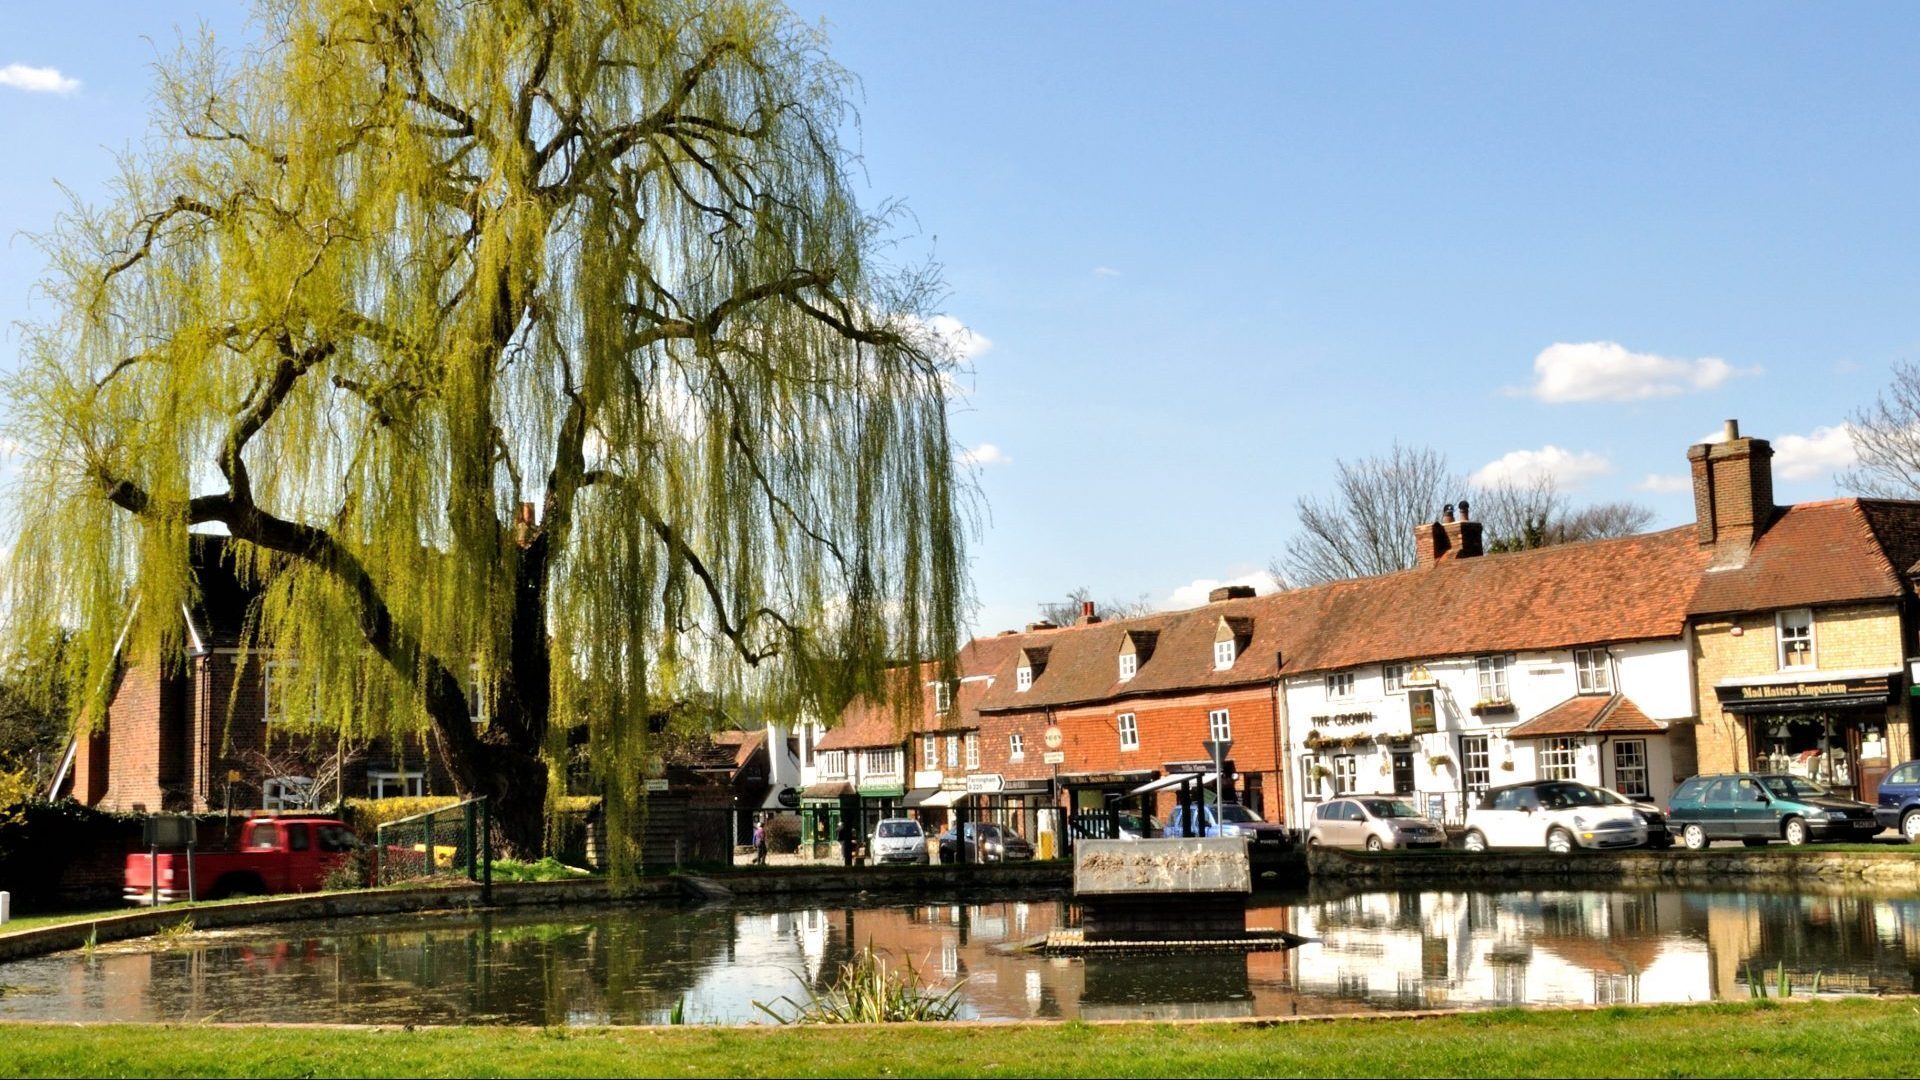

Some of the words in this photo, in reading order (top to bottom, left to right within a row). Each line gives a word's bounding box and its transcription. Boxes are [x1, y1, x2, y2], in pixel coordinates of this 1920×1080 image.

[1742, 687, 1762, 698] Mad
[1763, 685, 1797, 697] Hatters
[1798, 682, 1847, 697] Emporium
[1311, 715, 1330, 727] THE
[1334, 711, 1373, 726] CROWN
